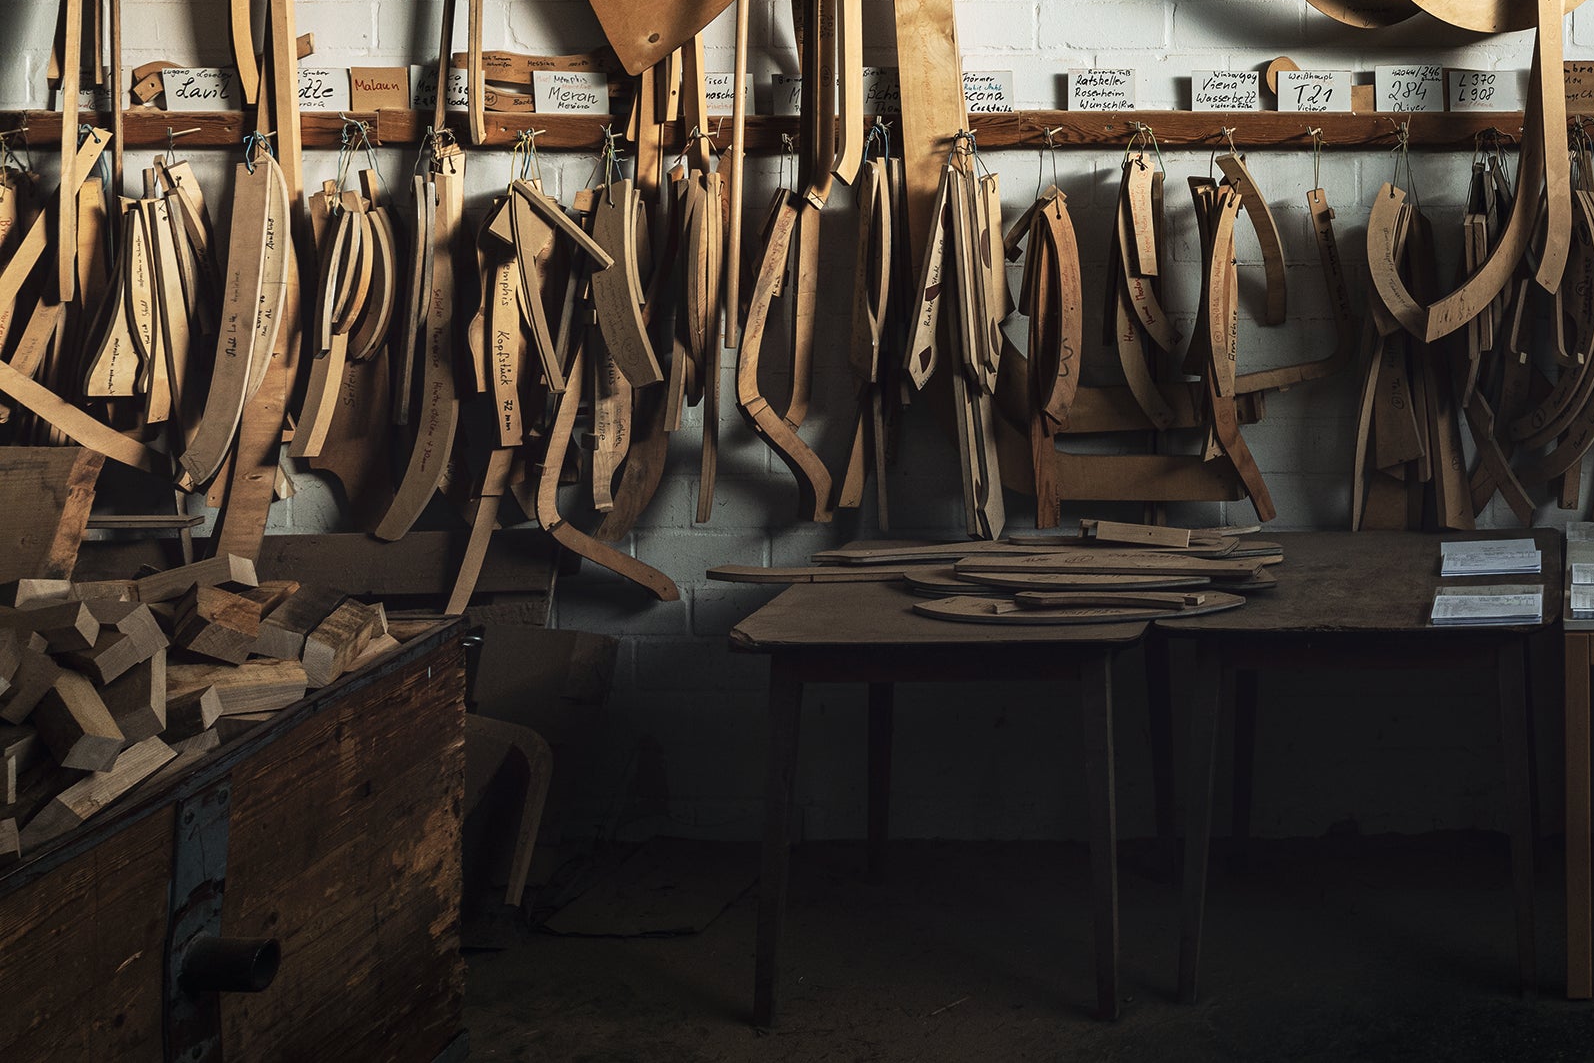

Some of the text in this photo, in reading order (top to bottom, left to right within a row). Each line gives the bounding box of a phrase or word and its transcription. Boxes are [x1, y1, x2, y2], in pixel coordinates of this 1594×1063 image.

[354, 80, 400, 92] Malaun
[1075, 74, 1126, 86] Ratskeller
[1203, 77, 1238, 90] Viena
[1458, 73, 1497, 87] L 370
[548, 86, 599, 105] Meran
[1075, 87, 1125, 97] Rosenheim
[1388, 80, 1427, 101] 284
[1458, 86, 1495, 102] L 908
[500, 261, 517, 307] emphis
[492, 330, 513, 386] Kopfstück
